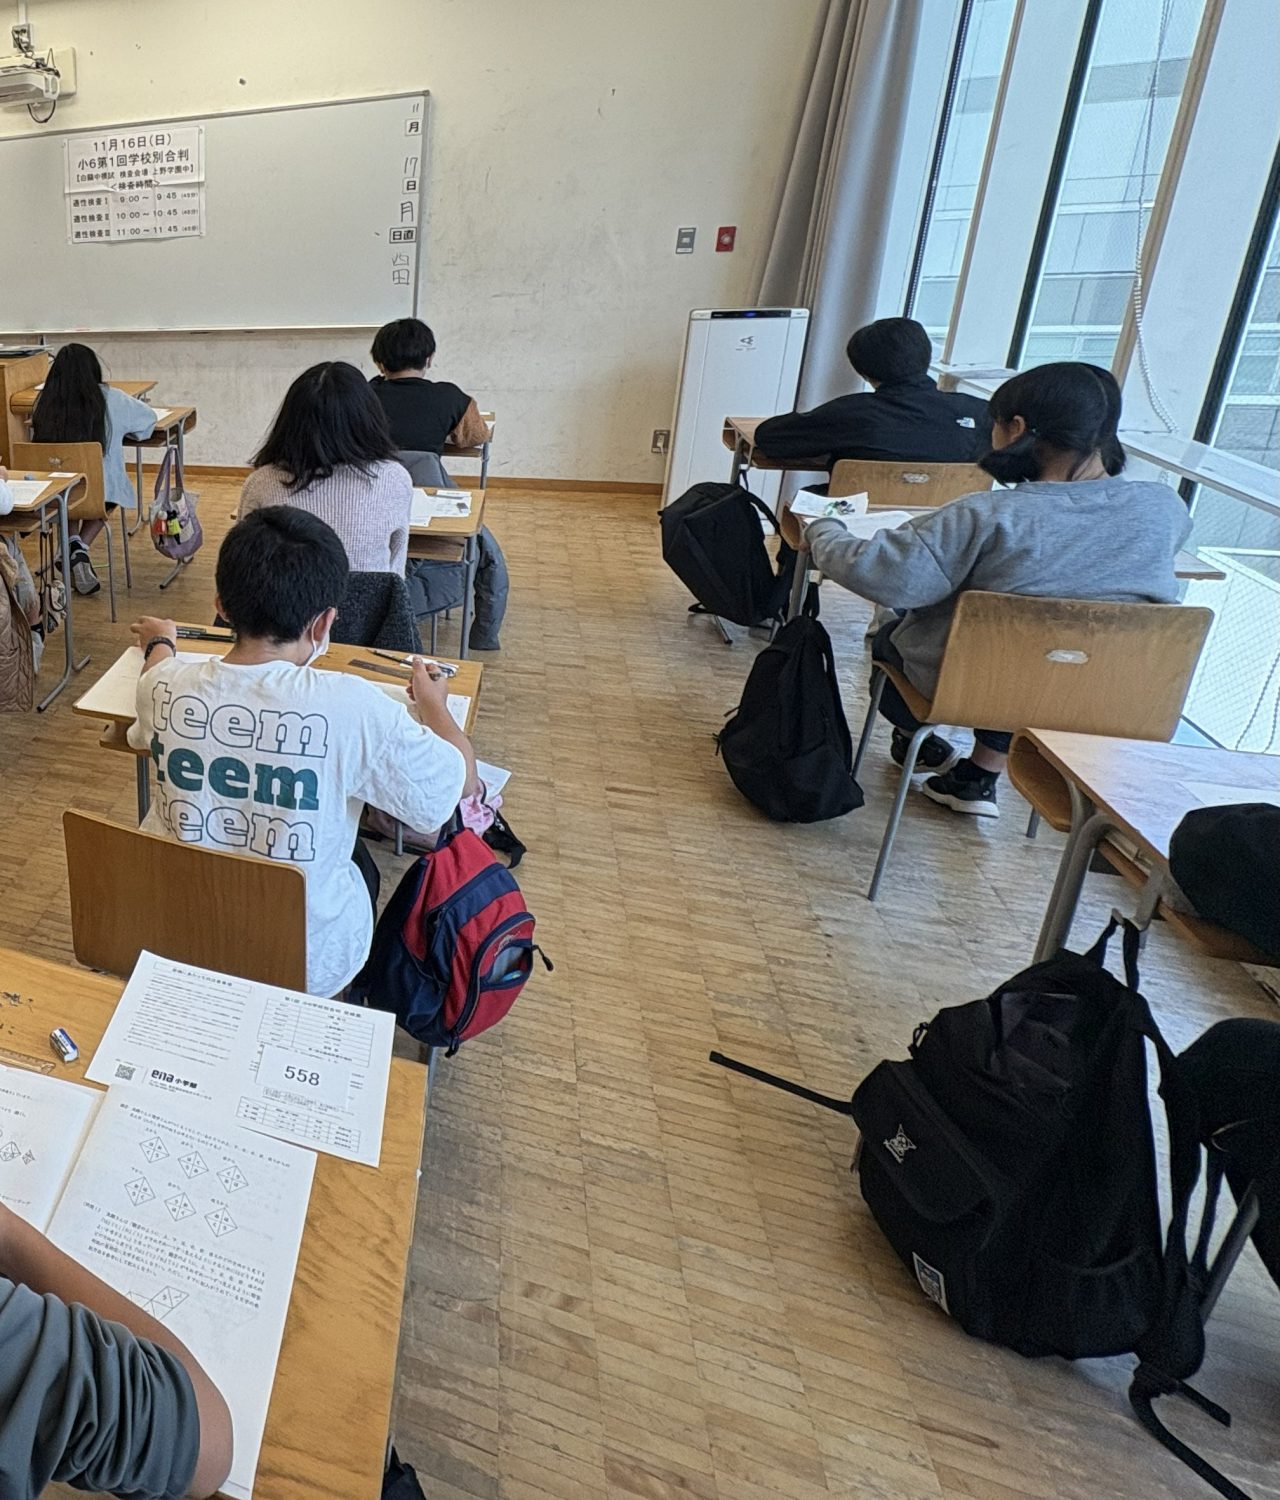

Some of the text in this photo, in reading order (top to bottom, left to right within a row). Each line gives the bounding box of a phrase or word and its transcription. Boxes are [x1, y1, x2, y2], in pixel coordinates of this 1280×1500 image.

[408, 121, 419, 133] 月
[78, 149, 189, 171] 小6第1回学校別合判
[393, 230, 414, 240] 日直
[152, 680, 329, 758] teem
[150, 731, 320, 811] teem
[284, 1065, 320, 1086] 558
